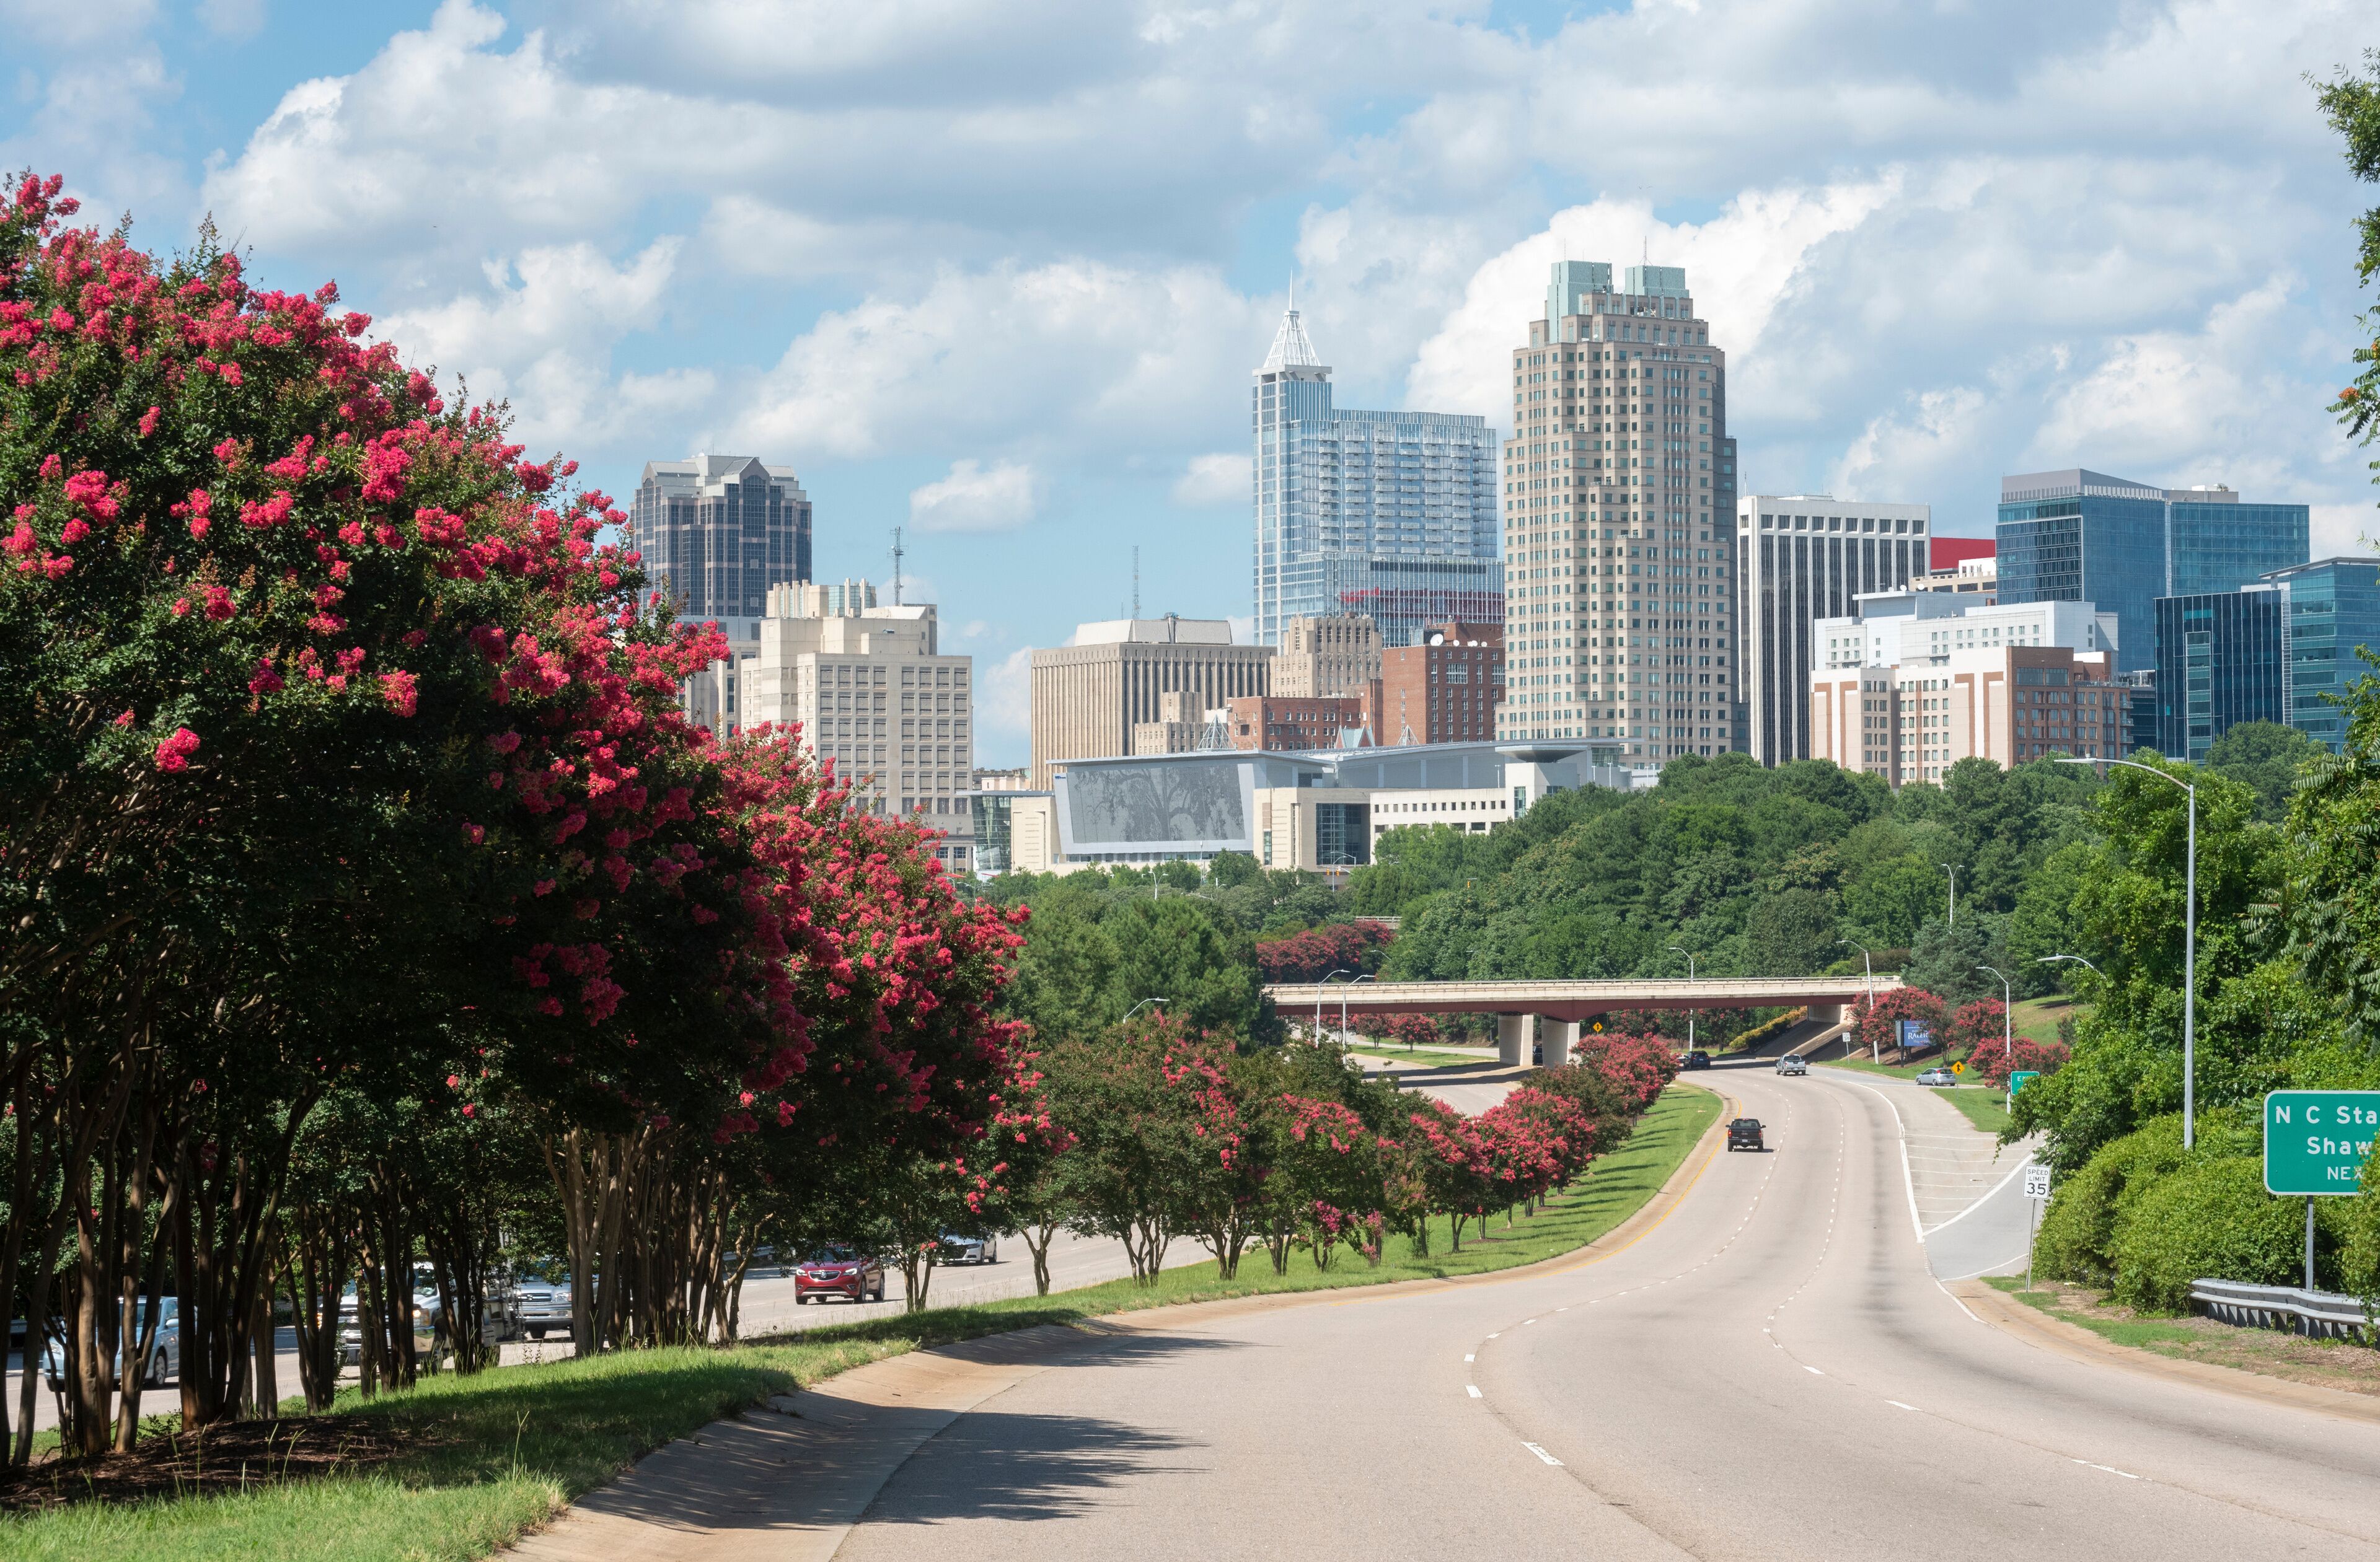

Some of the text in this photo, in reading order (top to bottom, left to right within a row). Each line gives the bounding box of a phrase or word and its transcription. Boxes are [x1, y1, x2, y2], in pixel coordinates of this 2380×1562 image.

[2275, 1105, 2378, 1124] N C Sta
[2306, 1136, 2373, 1155] Shaw
[2327, 1166, 2363, 1180] NEX
[2027, 1182, 2047, 1195] 35
